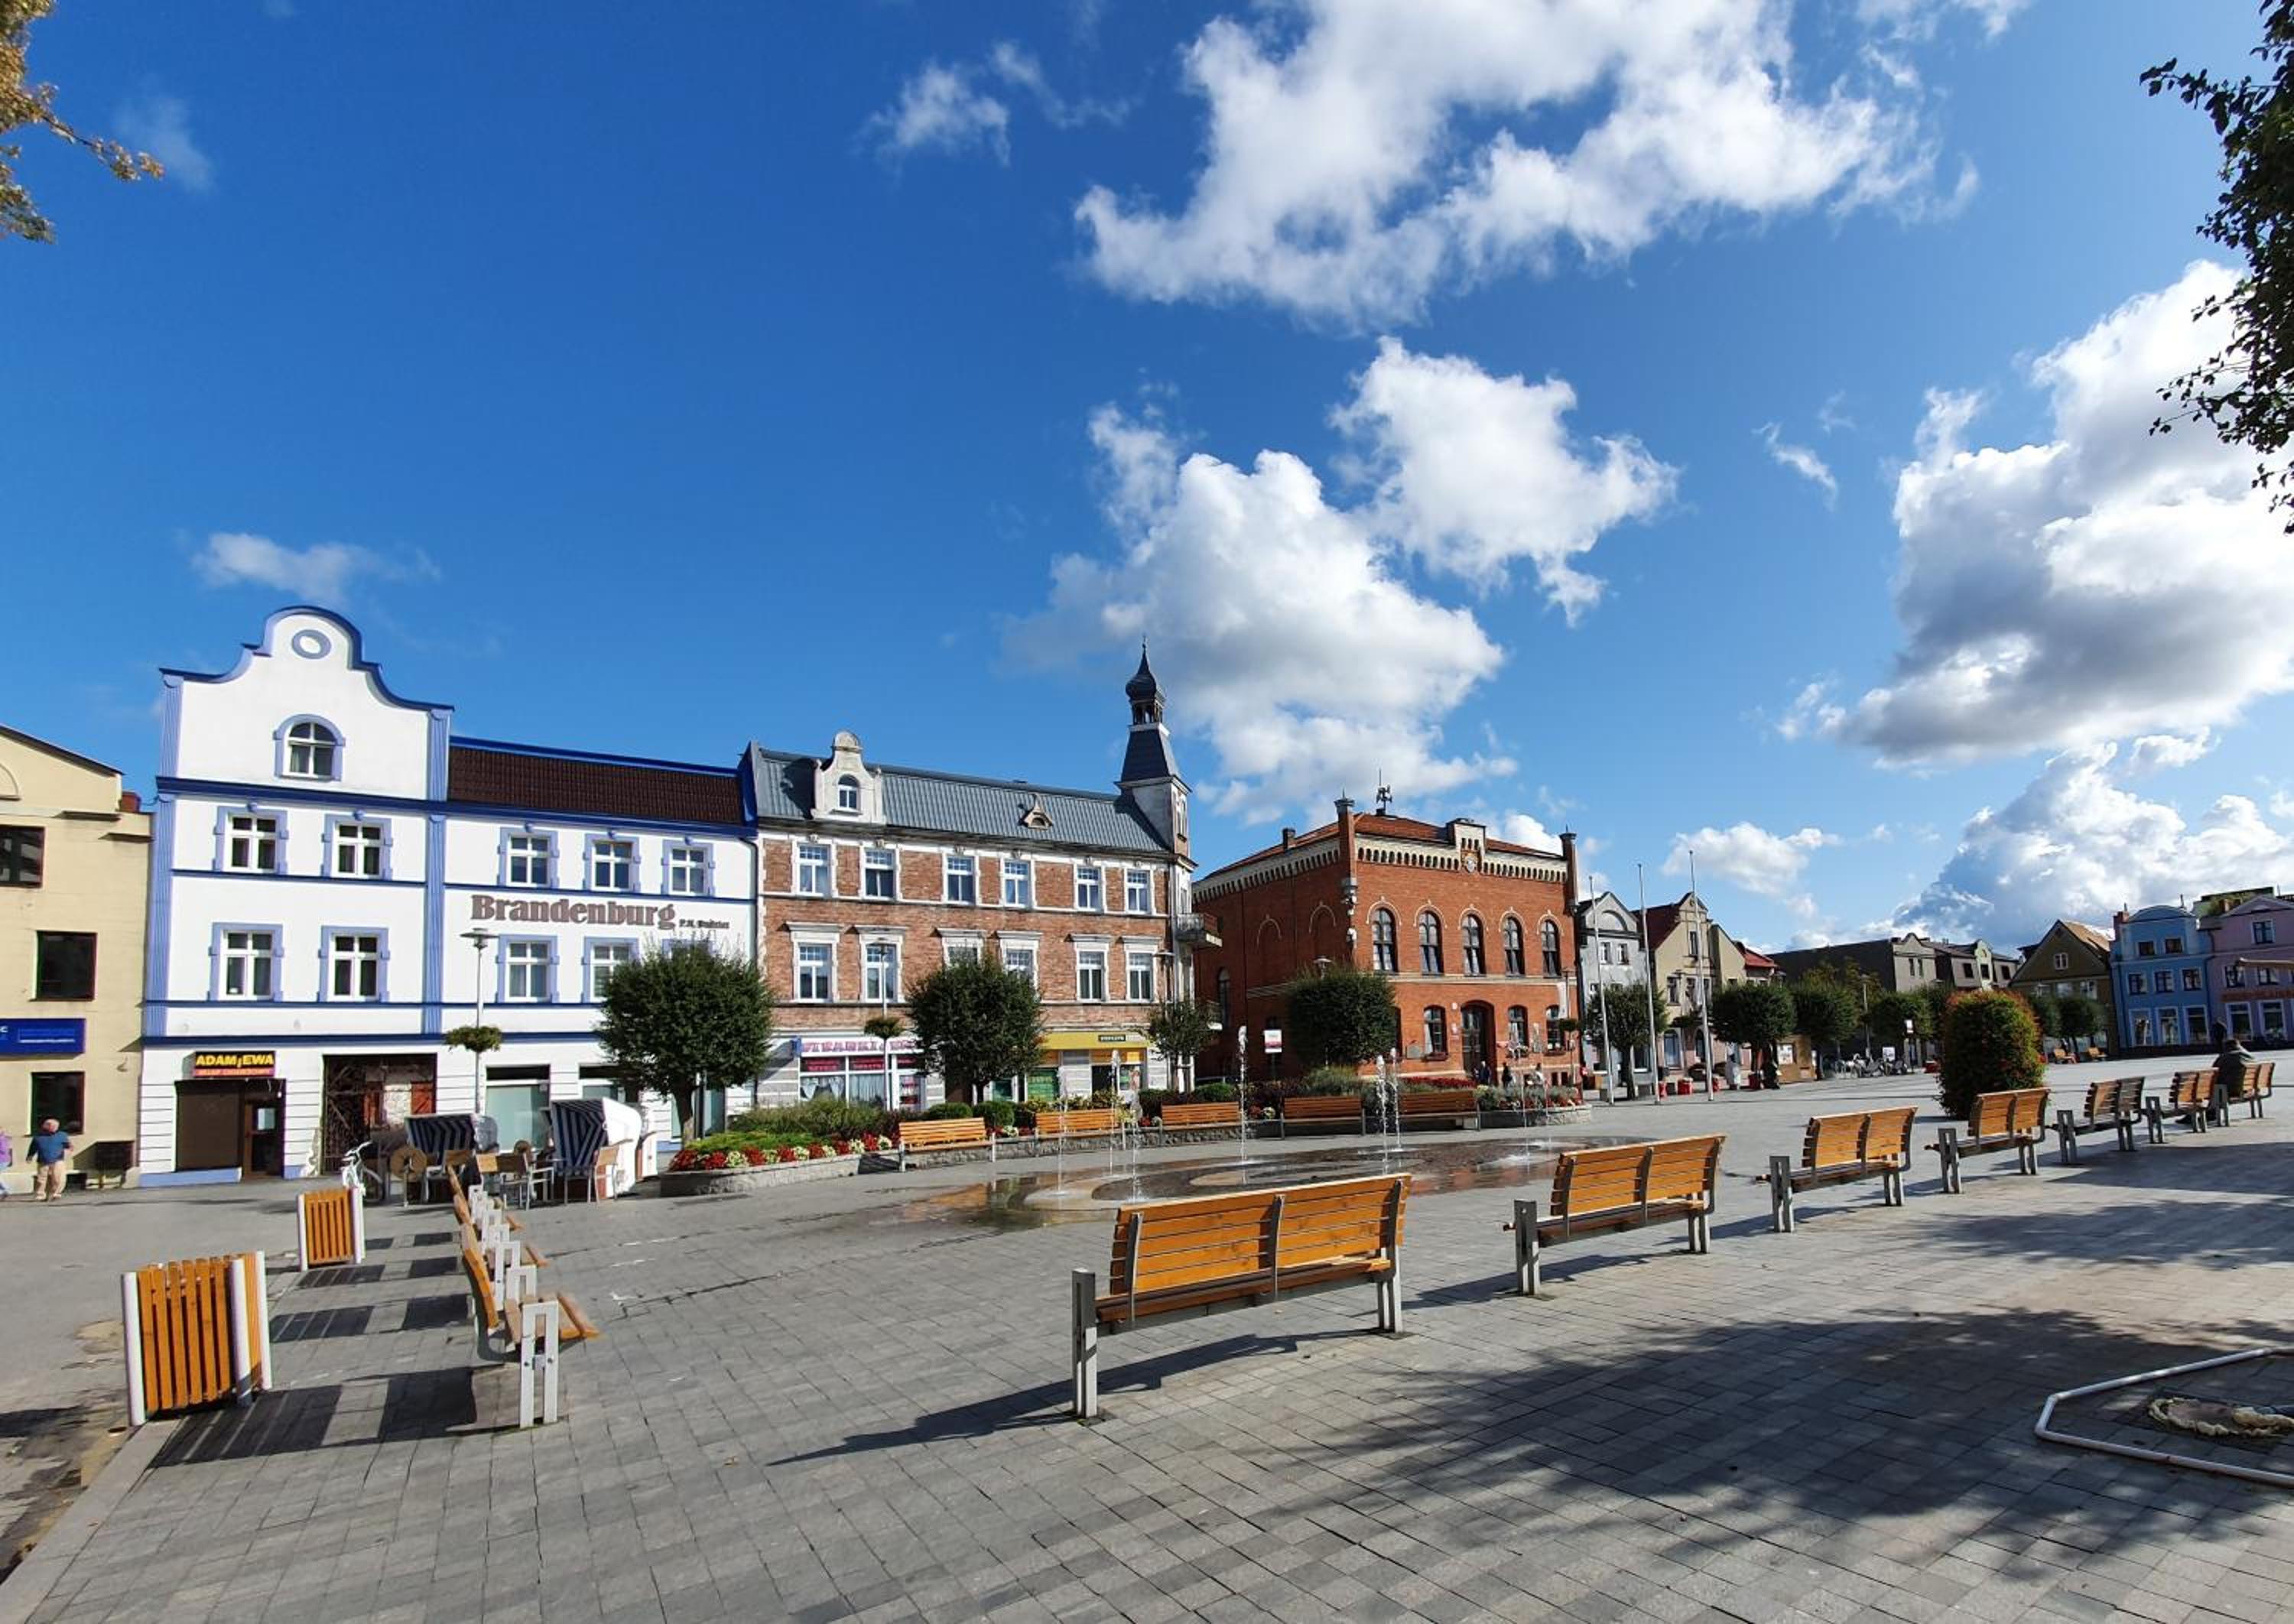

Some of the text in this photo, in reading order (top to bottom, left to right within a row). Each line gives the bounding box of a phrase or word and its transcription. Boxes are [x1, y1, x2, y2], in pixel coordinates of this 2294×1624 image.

[470, 894, 676, 930] Brandenburg
[196, 1054, 237, 1066] ADAM
[242, 1054, 275, 1065] EWA
